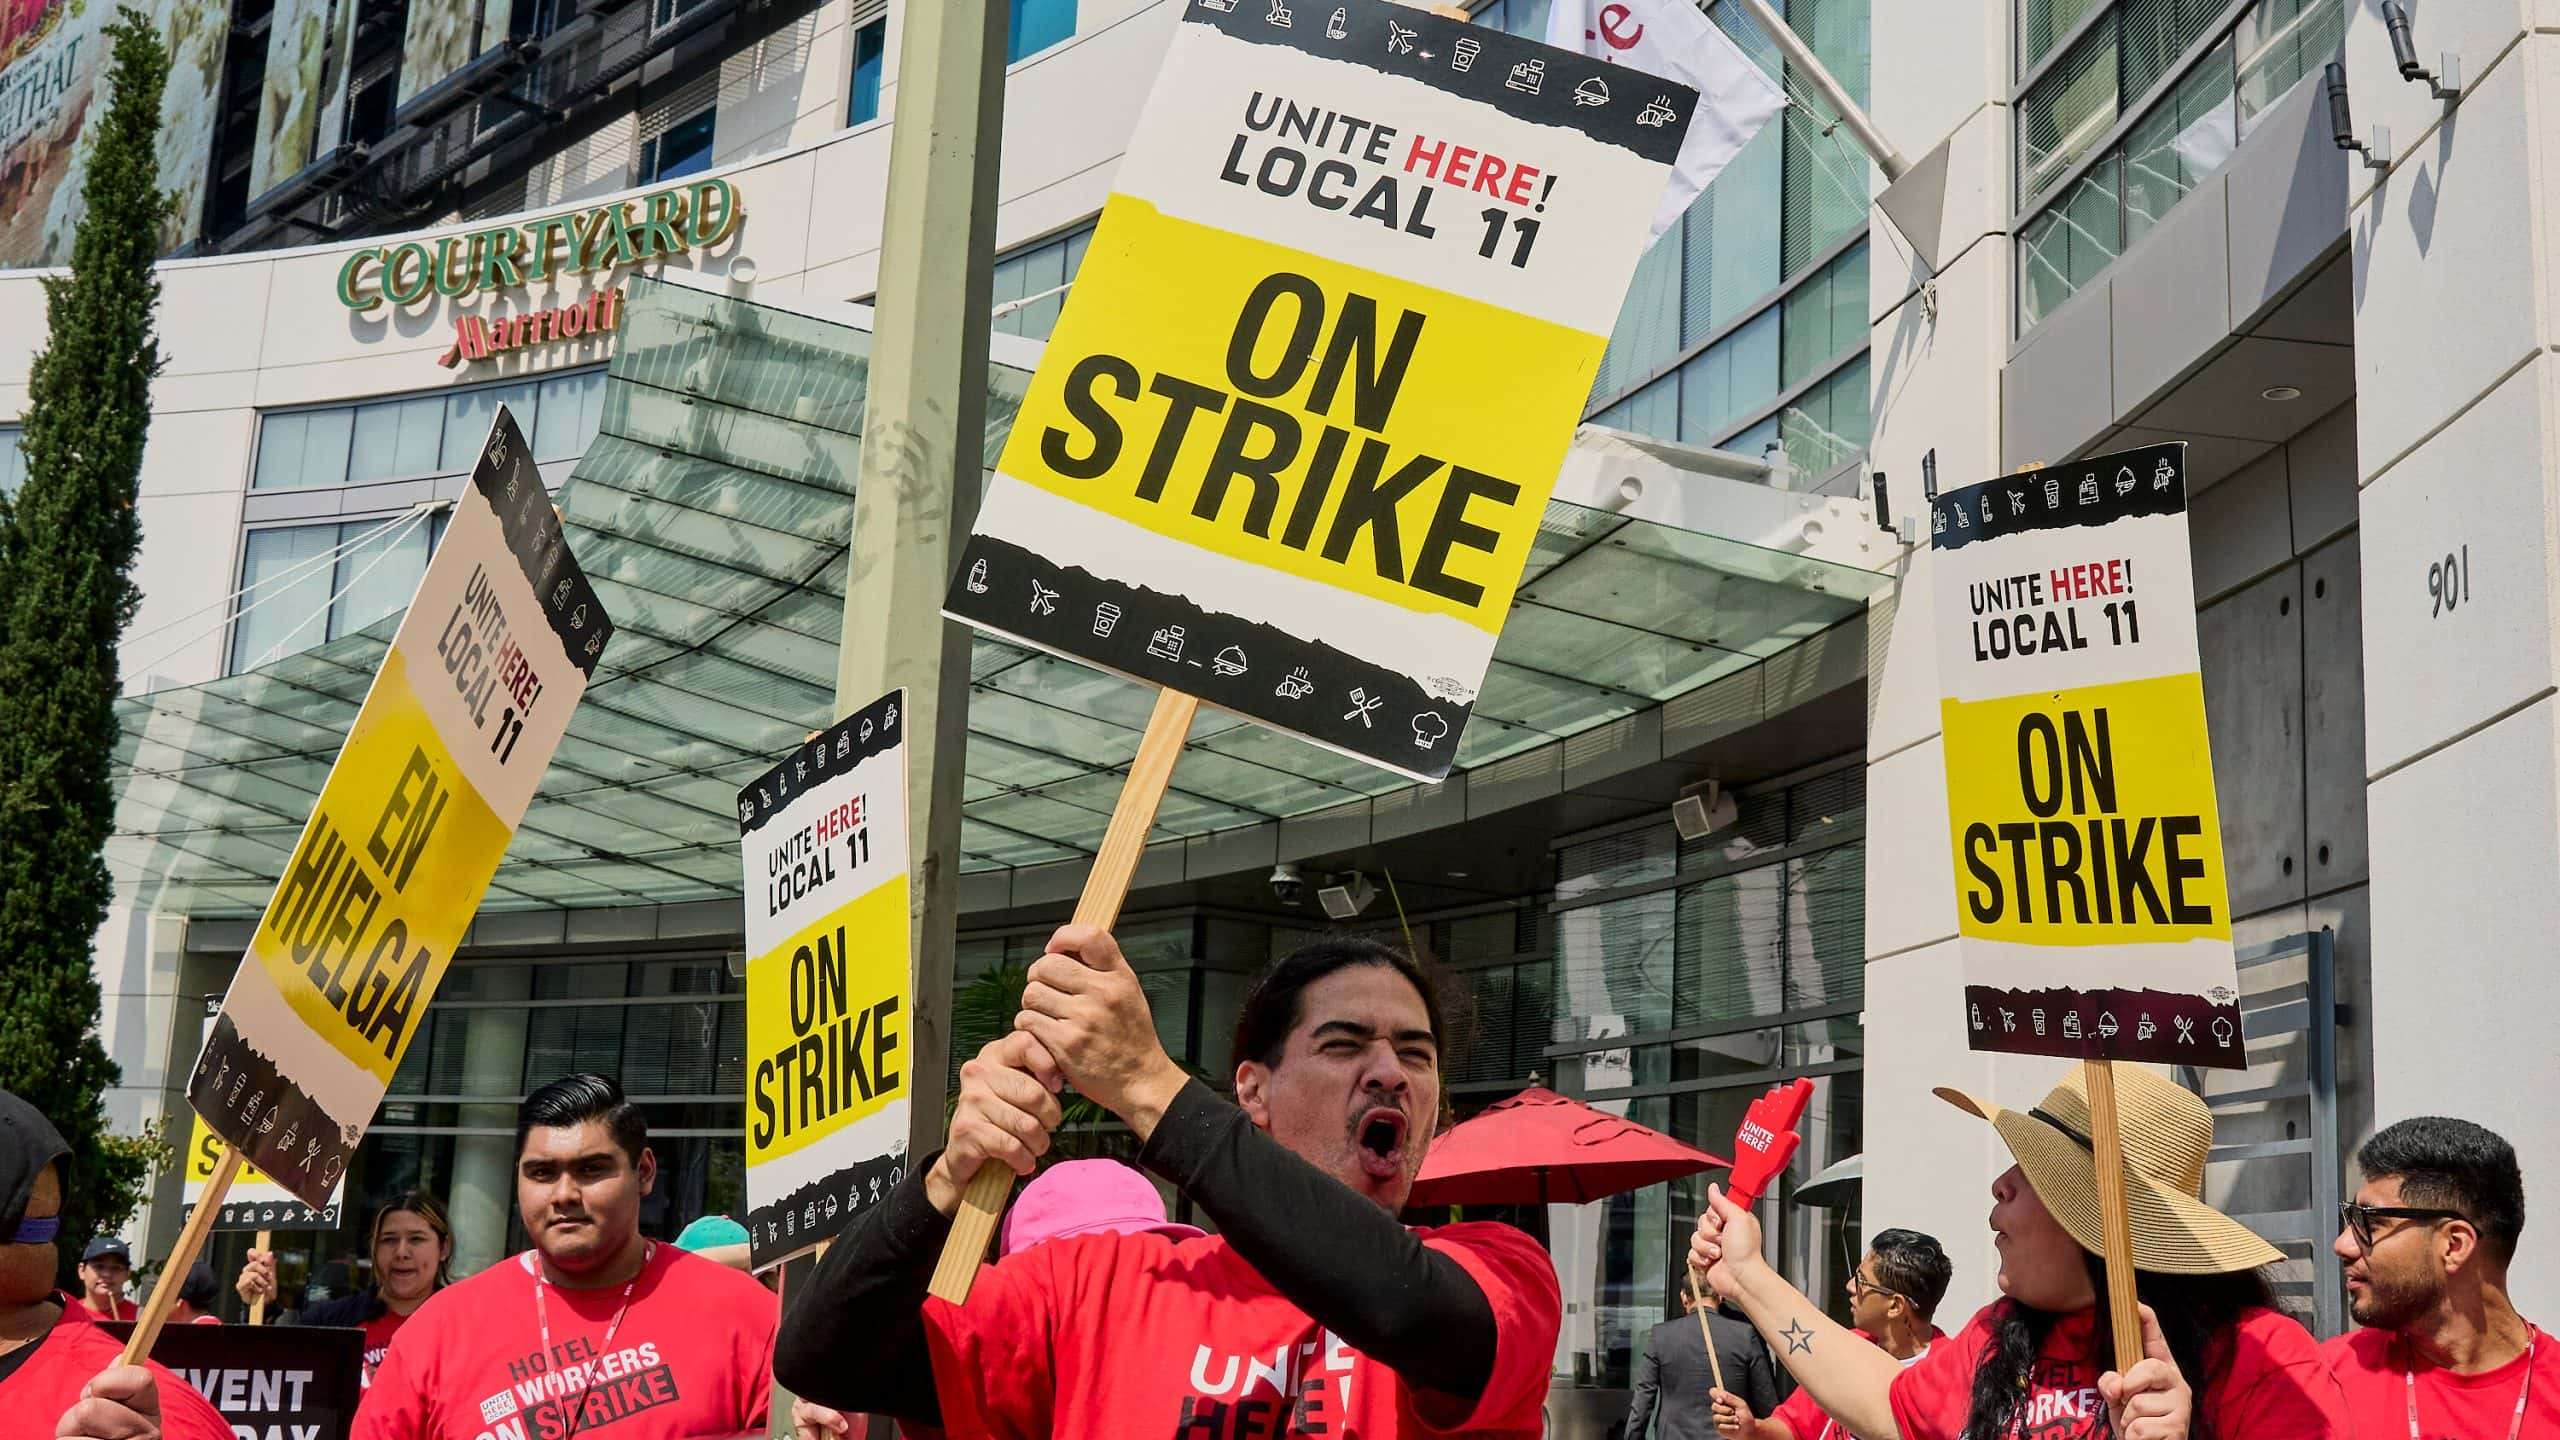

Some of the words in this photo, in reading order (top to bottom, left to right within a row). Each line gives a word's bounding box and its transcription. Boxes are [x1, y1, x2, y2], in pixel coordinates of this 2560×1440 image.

[18, 34, 83, 129] THAT
[1219, 134, 1436, 240] LOCAL
[1478, 207, 1541, 269] 11
[1244, 91, 1397, 166] UNITE
[1404, 134, 1558, 213] HERE!
[337, 179, 741, 310] COURTYARD
[438, 286, 622, 368] Marriott
[1225, 272, 1426, 434] ON
[1040, 353, 1521, 608] STRIKE
[1969, 573, 2042, 617] UNITE
[2050, 558, 2133, 603] HERE!
[1972, 608, 2088, 661] LOCAL
[2103, 600, 2139, 646] 11
[2428, 544, 2469, 619] 901
[437, 603, 498, 730] LOCAL
[490, 706, 524, 766] 11
[464, 563, 507, 655] UNITE
[494, 632, 543, 717] HERE!
[2017, 707, 2117, 818] ON
[366, 744, 449, 894] EN
[769, 825, 812, 878] UNITE
[816, 793, 867, 846] HERE!
[769, 846, 836, 918] LOCAL
[846, 826, 869, 869] 11
[1963, 815, 2212, 925] STRIKE
[269, 812, 432, 1061] HUELGA
[790, 925, 848, 1038] ON
[754, 995, 899, 1150] STRIKE
[1738, 1130, 1769, 1154] HERE!
[1743, 1119, 1775, 1145] UNITE
[168, 1368, 313, 1412] VENT
[507, 1336, 598, 1381] HOTEL
[515, 1342, 661, 1405] WORKERS
